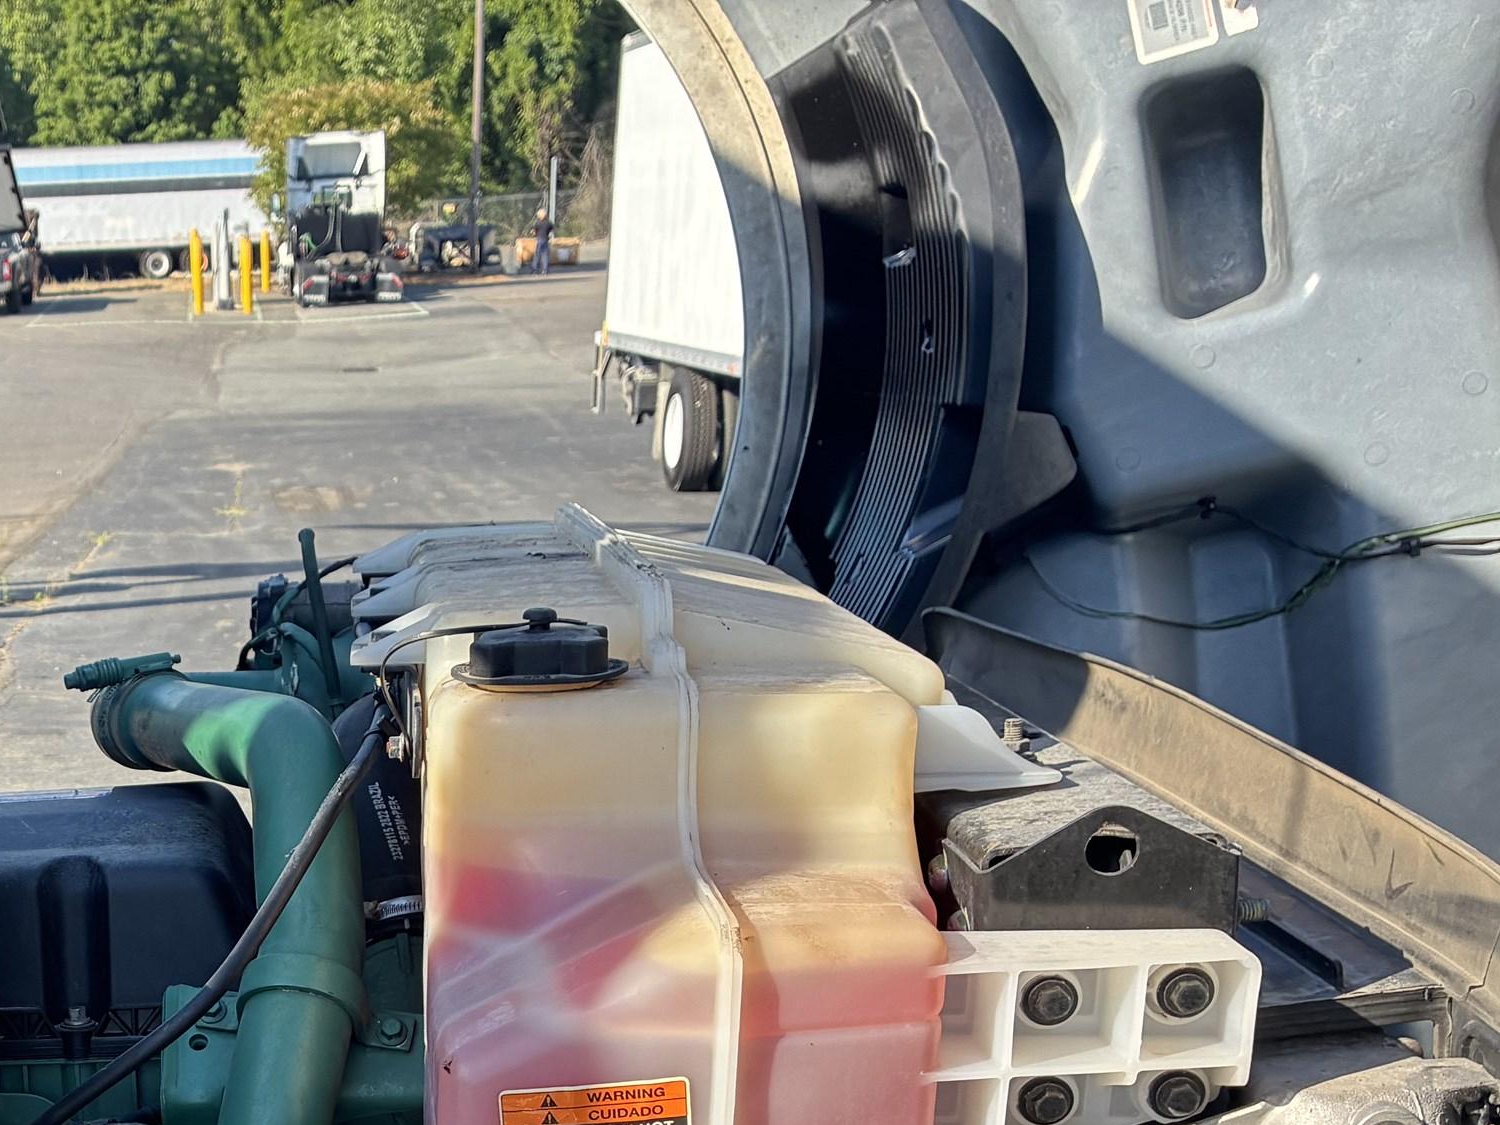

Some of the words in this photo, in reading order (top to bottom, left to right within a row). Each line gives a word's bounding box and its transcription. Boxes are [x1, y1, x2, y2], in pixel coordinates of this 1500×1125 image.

[368, 781, 386, 810] BRAZIL
[587, 1087, 666, 1103] WARNING
[588, 1105, 664, 1121] CUIDADO
